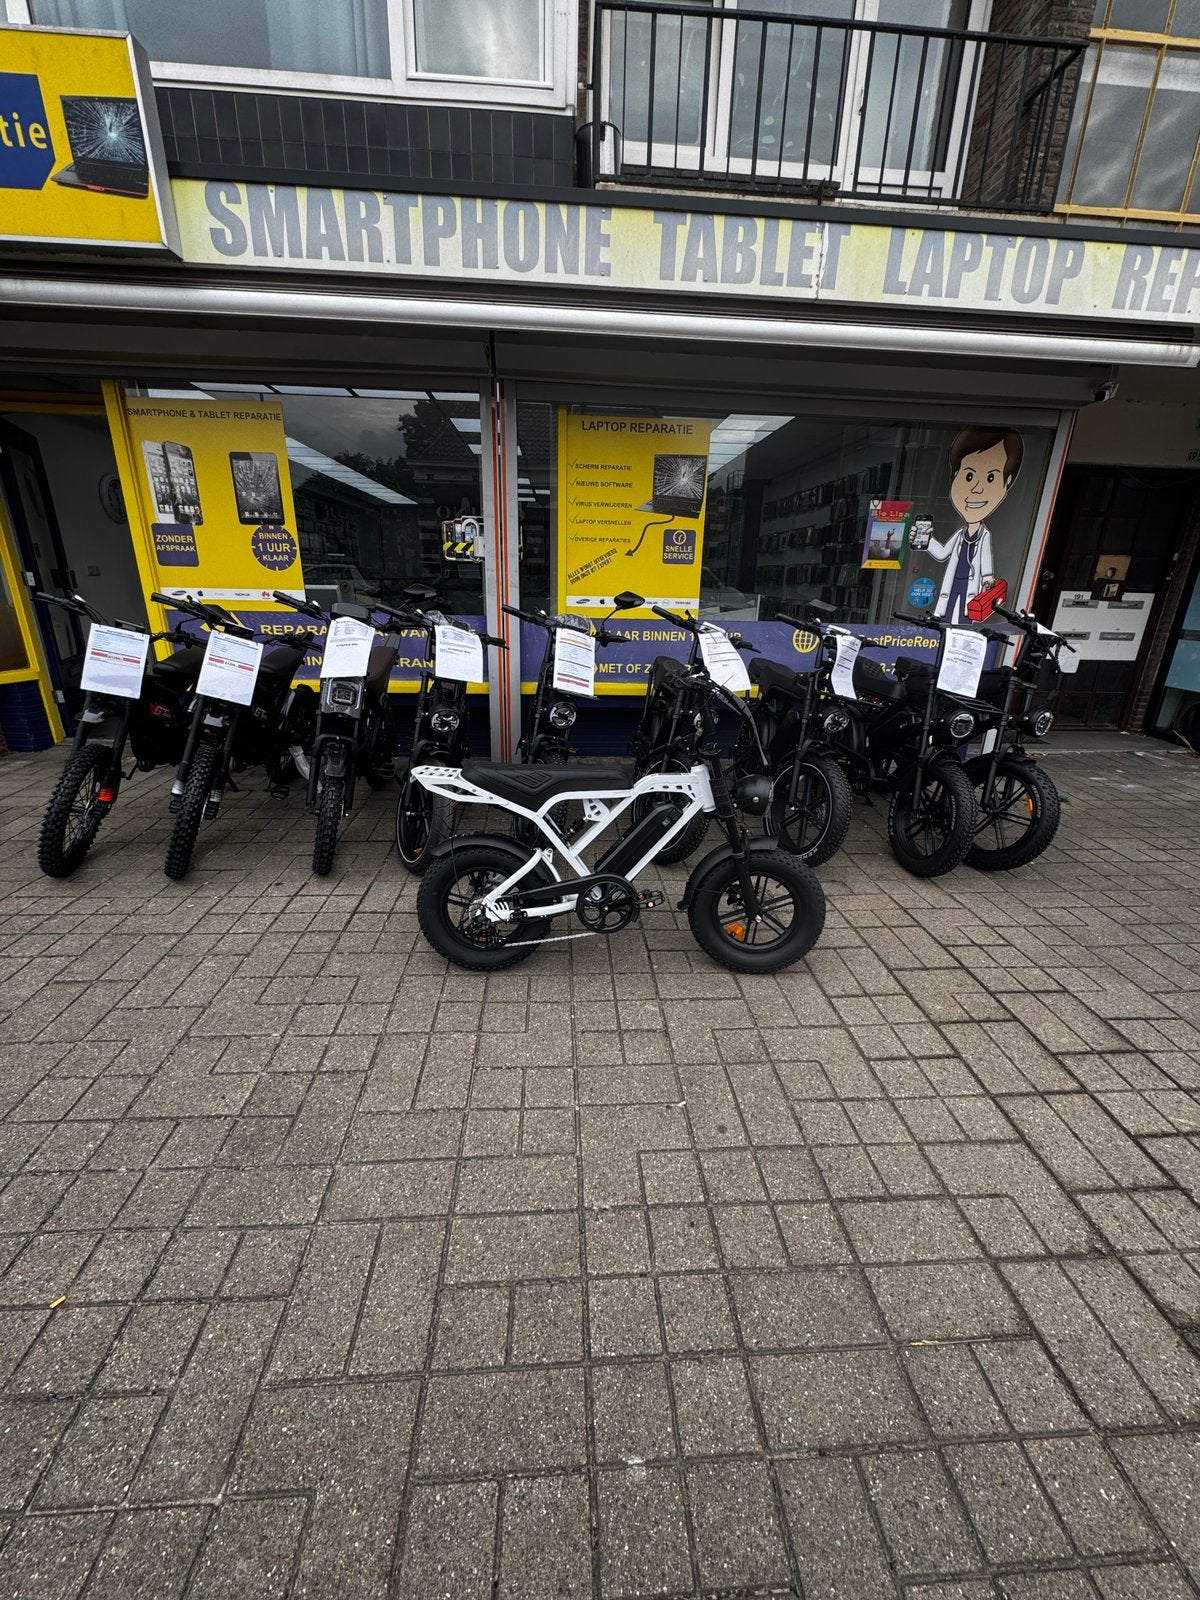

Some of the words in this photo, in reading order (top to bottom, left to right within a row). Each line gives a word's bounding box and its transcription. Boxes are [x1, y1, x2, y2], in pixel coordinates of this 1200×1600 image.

[205, 181, 611, 278] SMARTPHONE
[654, 214, 850, 290] TABLET
[883, 227, 1085, 304] LAPTOP
[128, 407, 187, 417] SMARTPHONE
[198, 410, 231, 419] TABLET
[234, 411, 282, 421] REPARATIE
[581, 420, 626, 432] LAPTOP
[630, 422, 693, 434] REPARATIE
[156, 534, 193, 543] ZONDER
[259, 532, 288, 540] BINNEN
[257, 543, 263, 552] 1
[267, 543, 291, 553] UUR
[665, 545, 693, 553] SNELLE
[262, 554, 289, 562] KLAAR
[663, 552, 693, 560] SERVICE
[643, 630, 686, 642] BINNEN
[599, 663, 623, 674] MET
[626, 663, 642, 674] OF
